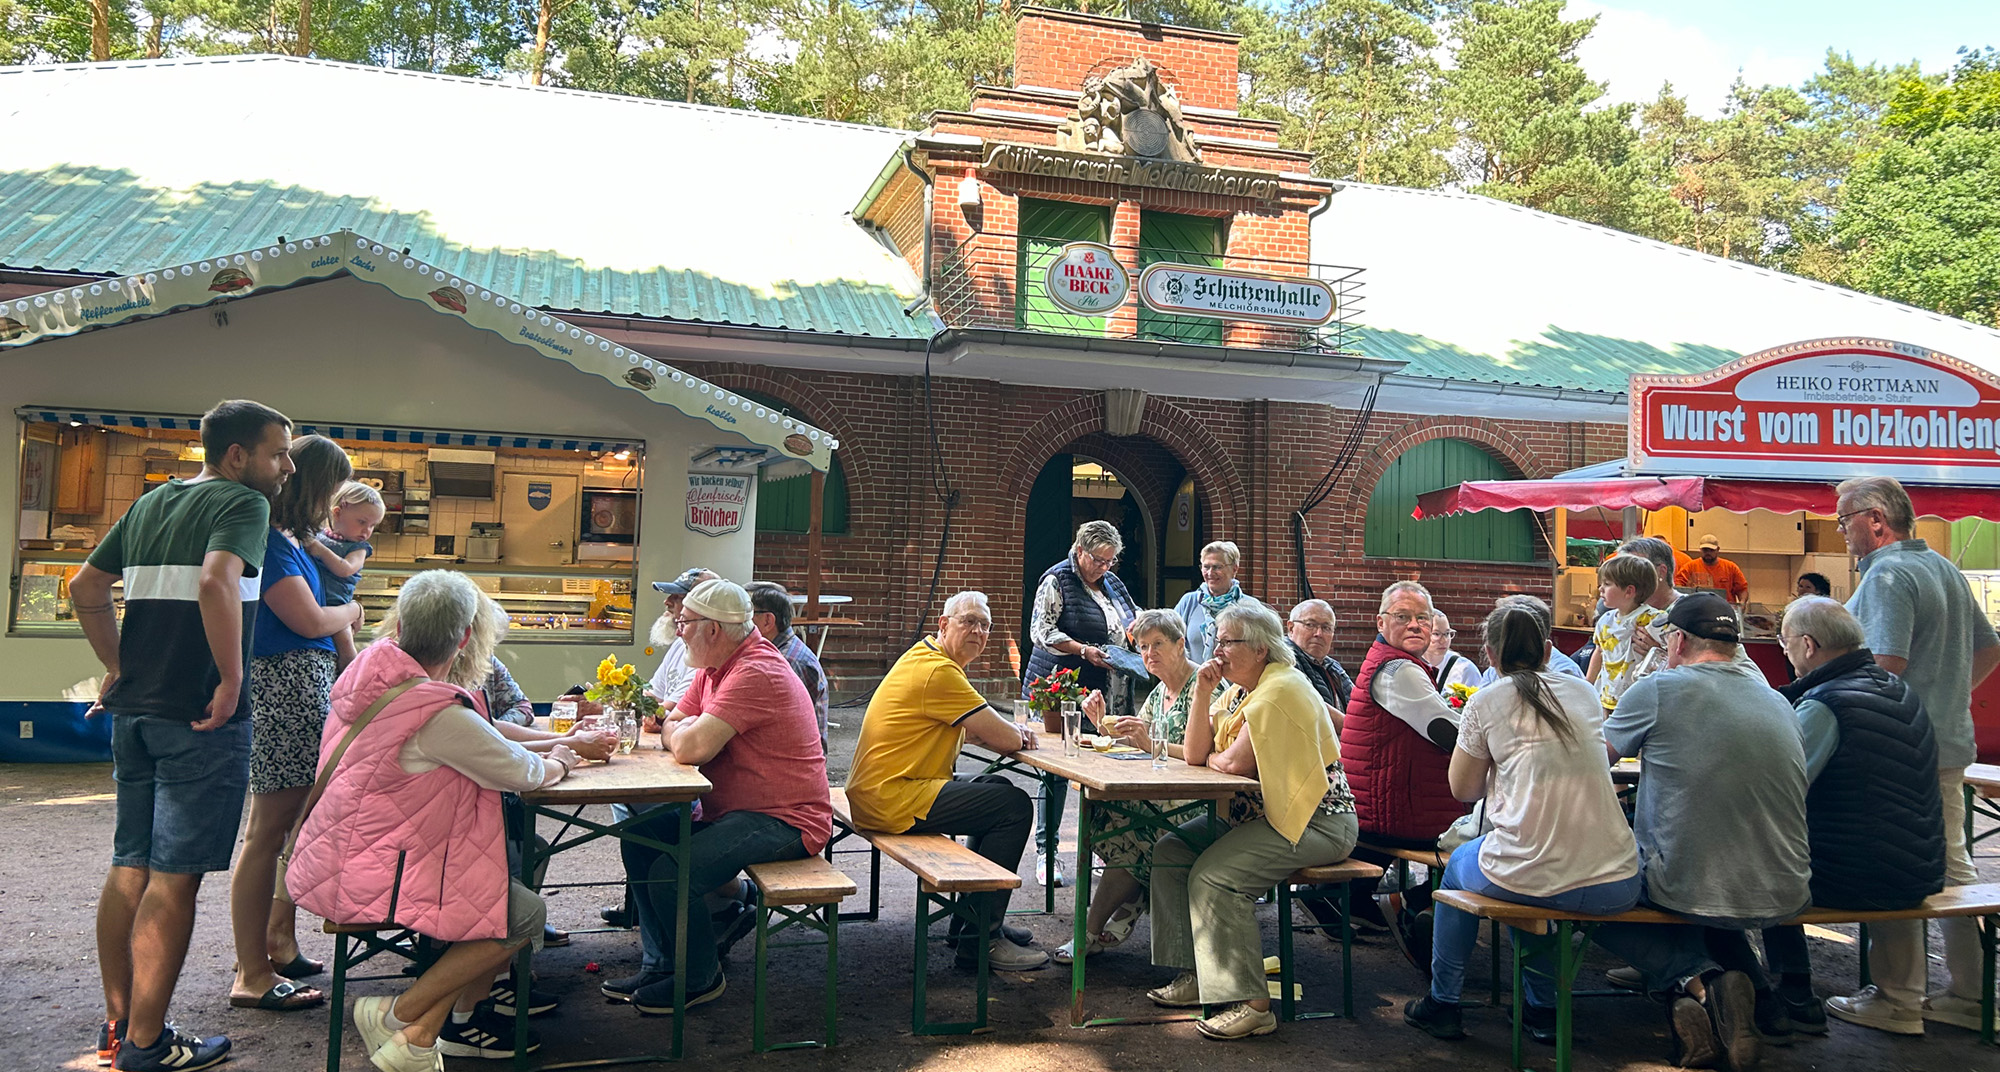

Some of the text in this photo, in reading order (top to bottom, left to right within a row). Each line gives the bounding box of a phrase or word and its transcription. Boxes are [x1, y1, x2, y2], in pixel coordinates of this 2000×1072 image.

[311, 256, 339, 268] echter
[1064, 264, 1114, 281] HAAKE
[1069, 279, 1110, 295] BECK
[1193, 276, 1321, 308] Schützenhalle
[1078, 295, 1100, 306] Pils
[1209, 302, 1305, 317] MELCHIORSHAUSEN
[1776, 376, 1939, 393] HEIKO FORTMANN
[1803, 391, 1876, 402] Imbissbetriebe
[1885, 393, 1913, 403] Stuhr
[1661, 404, 1747, 443] Wurst
[1758, 411, 1819, 445] vom
[701, 475, 724, 486] backen
[691, 506, 738, 527] Brötchen
